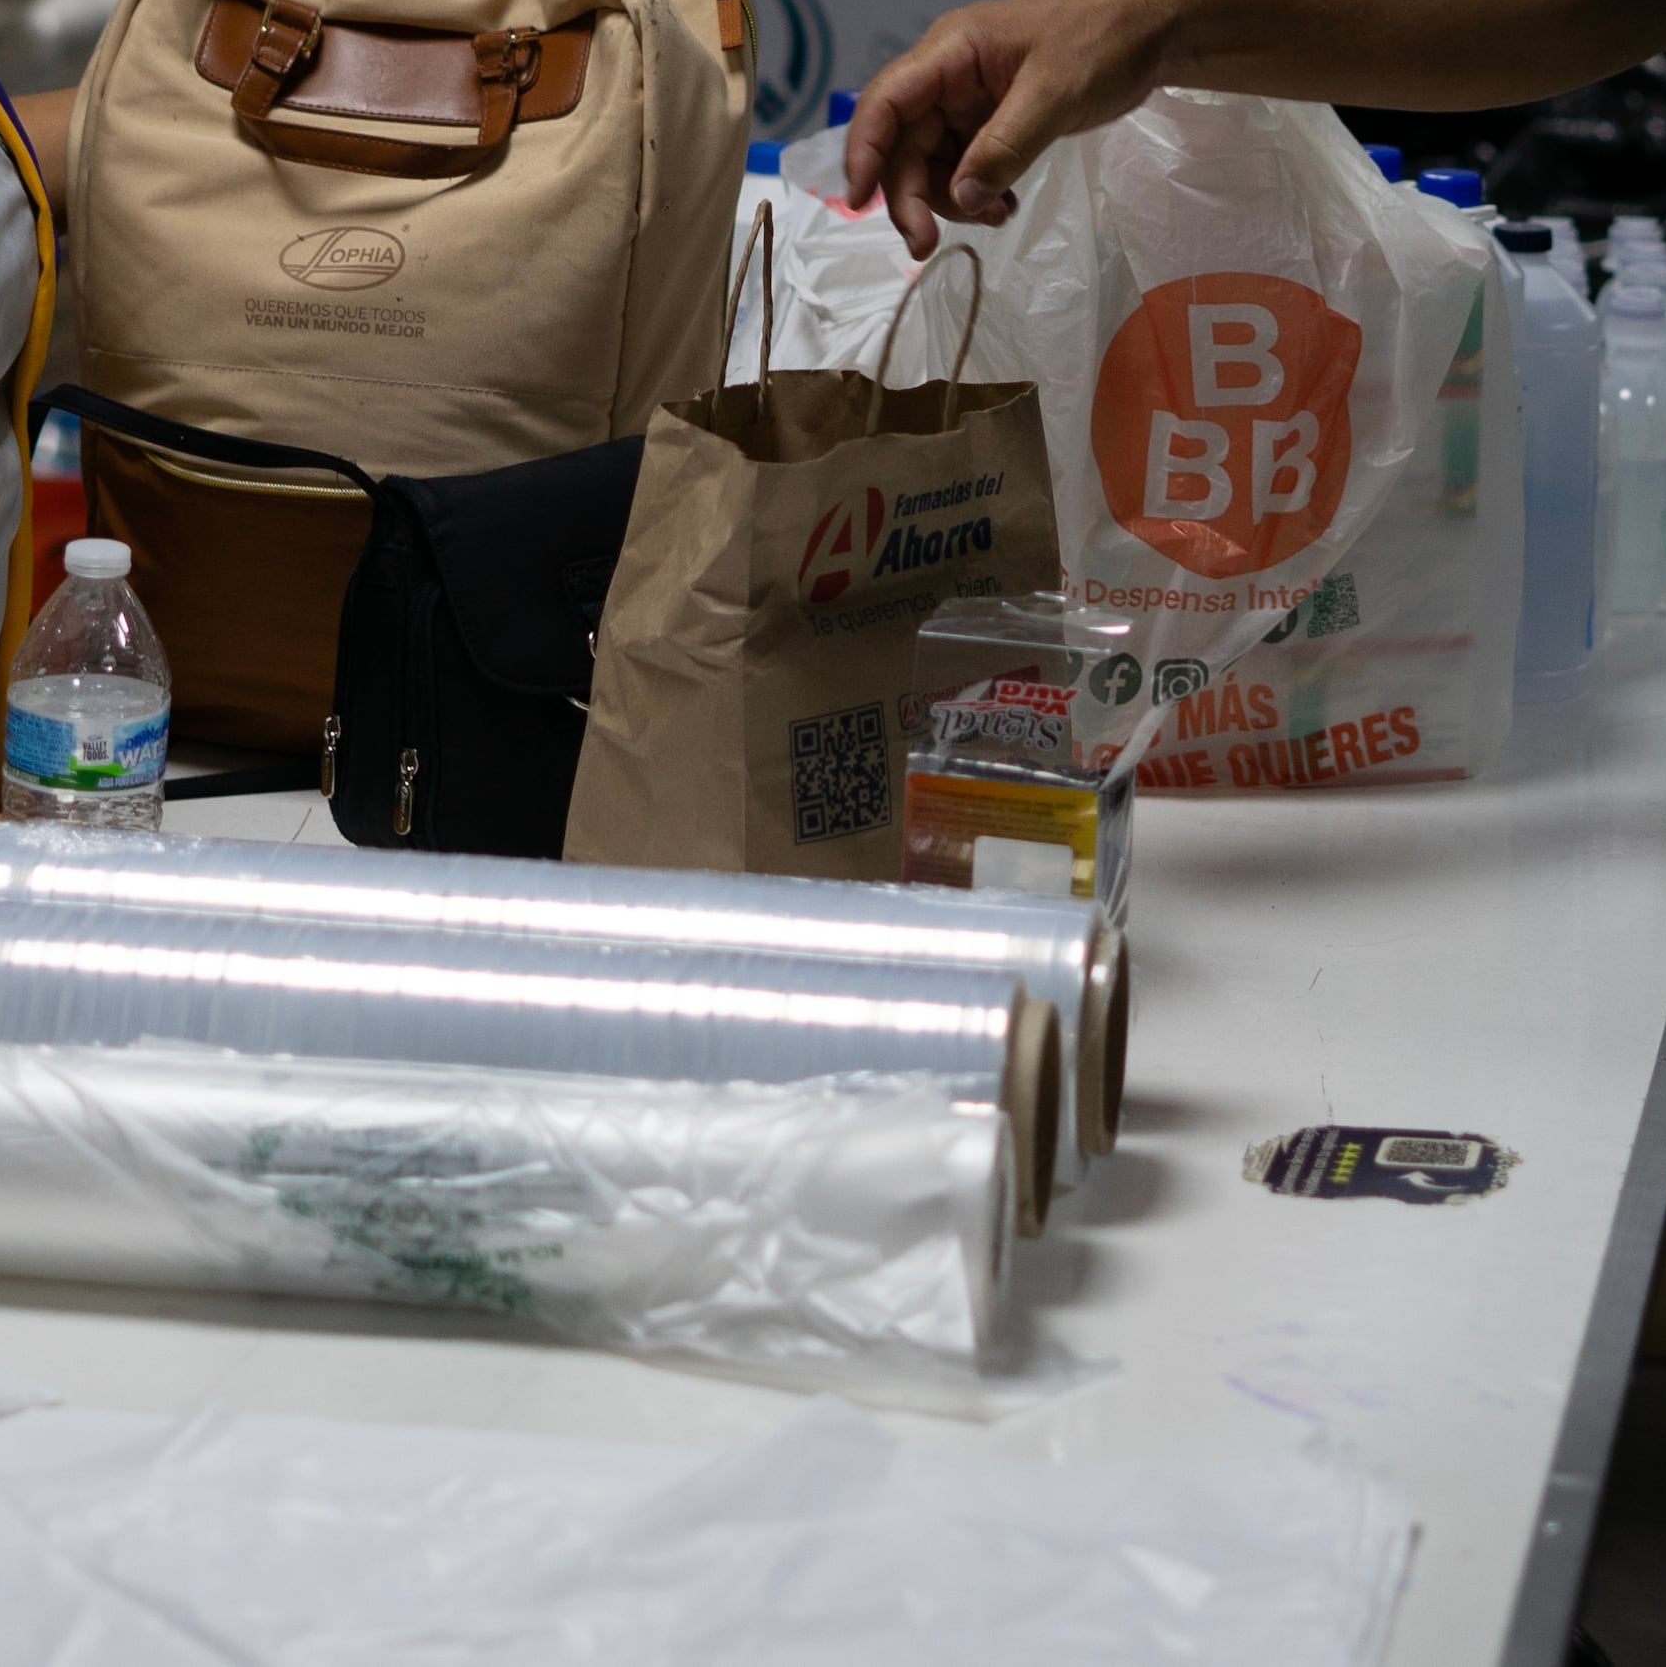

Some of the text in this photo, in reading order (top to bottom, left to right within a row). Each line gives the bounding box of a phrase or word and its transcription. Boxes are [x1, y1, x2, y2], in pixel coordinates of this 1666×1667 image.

[244, 297, 427, 325] QUEREMOS QUE TODOS
[244, 313, 427, 339] VEAN UN MUNDO MEJOR
[893, 471, 1005, 520] Farmacias del
[872, 516, 993, 579] Ahorro
[837, 592, 937, 634] queremos
[1085, 579, 1237, 614] Despensa
[1177, 671, 1279, 741] MÁS
[83, 741, 107, 751] VALLEY
[939, 708, 1063, 750] Signal
[1228, 705, 1420, 788] QUIERES
